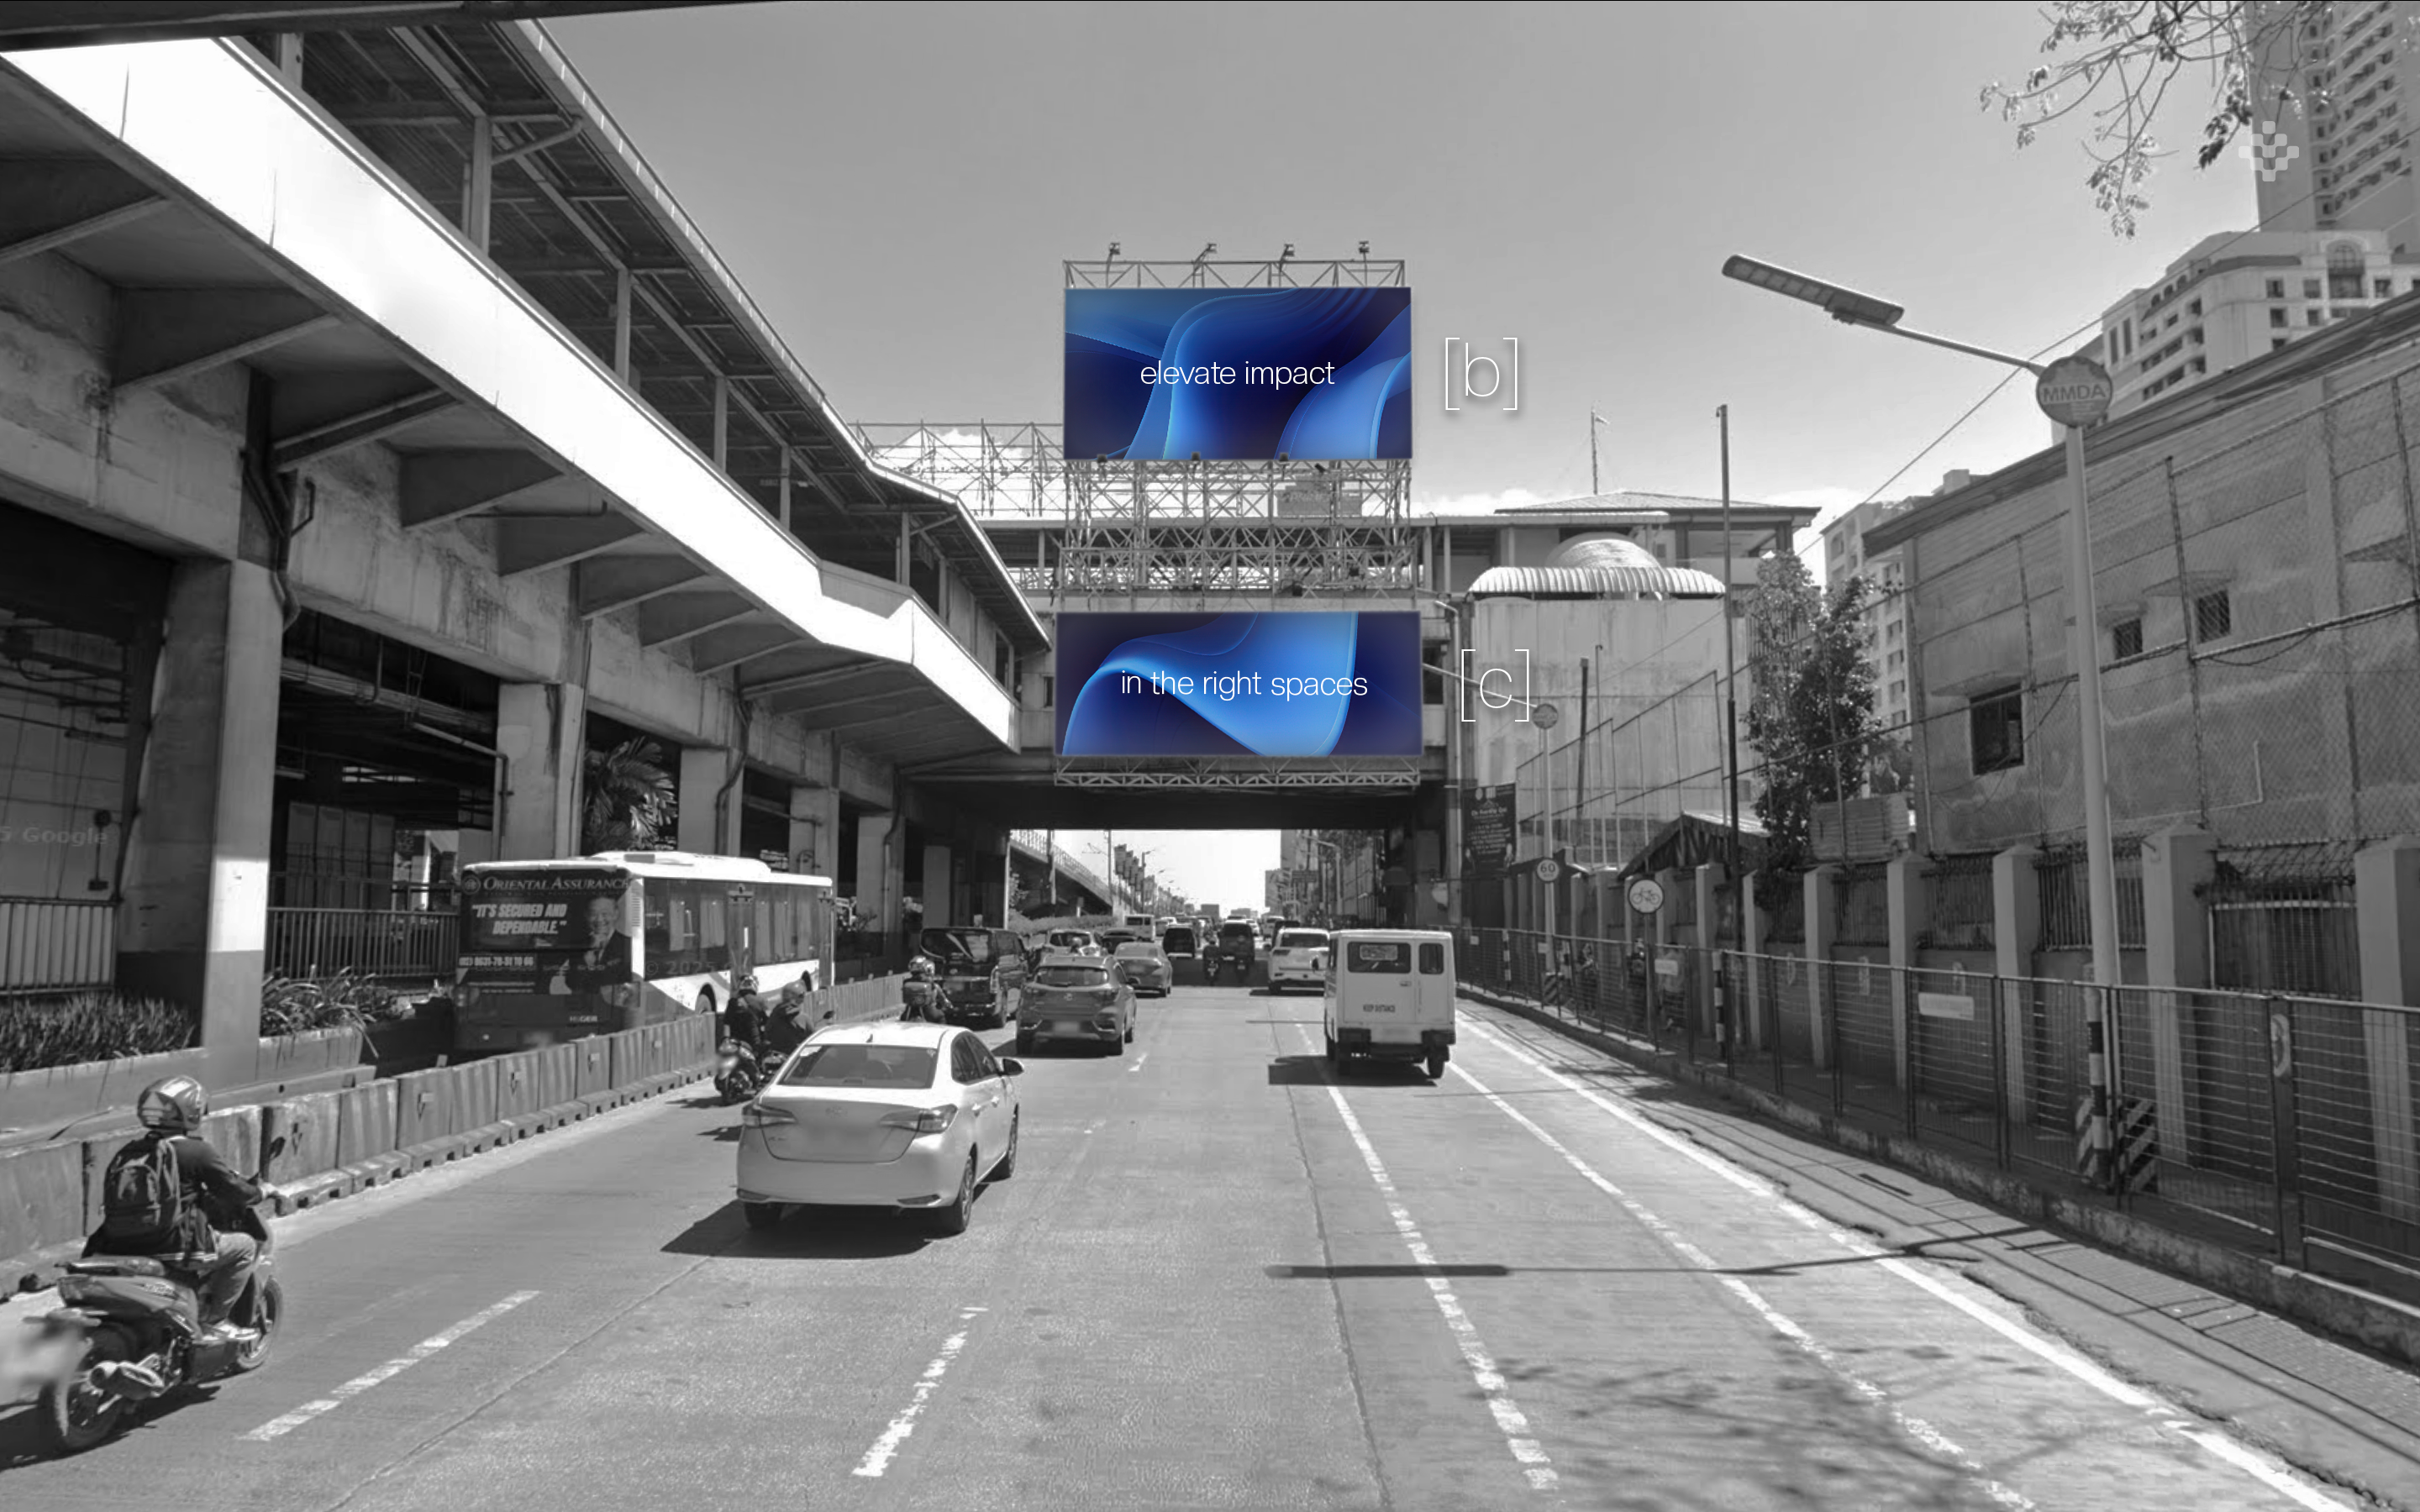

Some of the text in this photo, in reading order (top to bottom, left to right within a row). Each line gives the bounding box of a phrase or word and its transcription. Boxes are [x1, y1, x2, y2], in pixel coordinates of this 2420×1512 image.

[1140, 360, 1335, 391] elevate impact
[2043, 384, 2106, 402] MMDA
[1122, 669, 1368, 702] in the right spaces
[1540, 863, 1555, 873] 60
[498, 904, 544, 918] SECURED
[544, 904, 567, 918] AND
